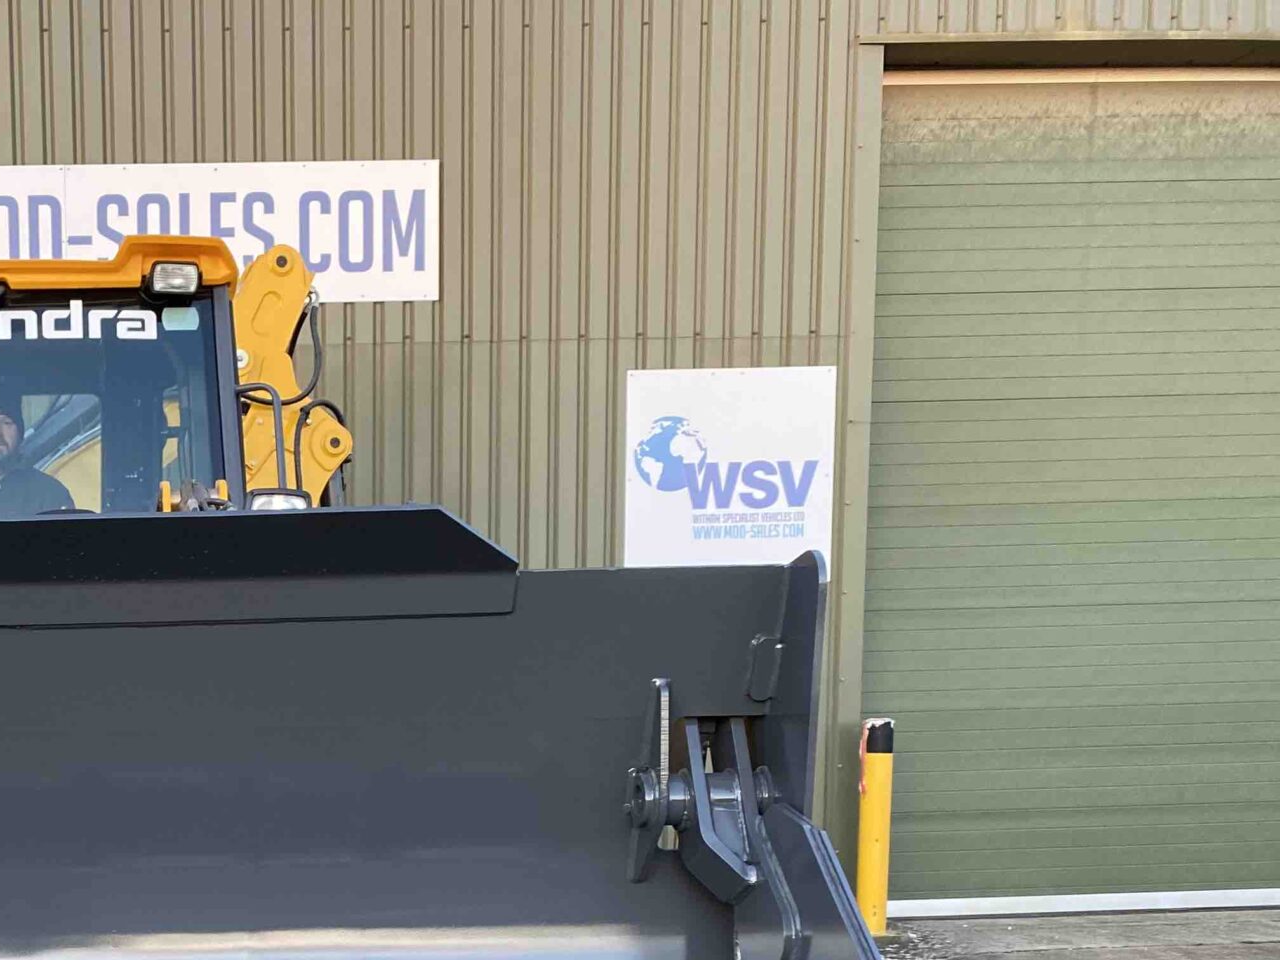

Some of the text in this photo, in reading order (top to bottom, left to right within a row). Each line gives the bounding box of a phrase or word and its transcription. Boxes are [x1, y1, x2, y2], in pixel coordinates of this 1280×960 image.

[683, 460, 819, 509] WSV
[723, 513, 760, 523] SPECIALIST
[761, 512, 792, 522] VEHICLES
